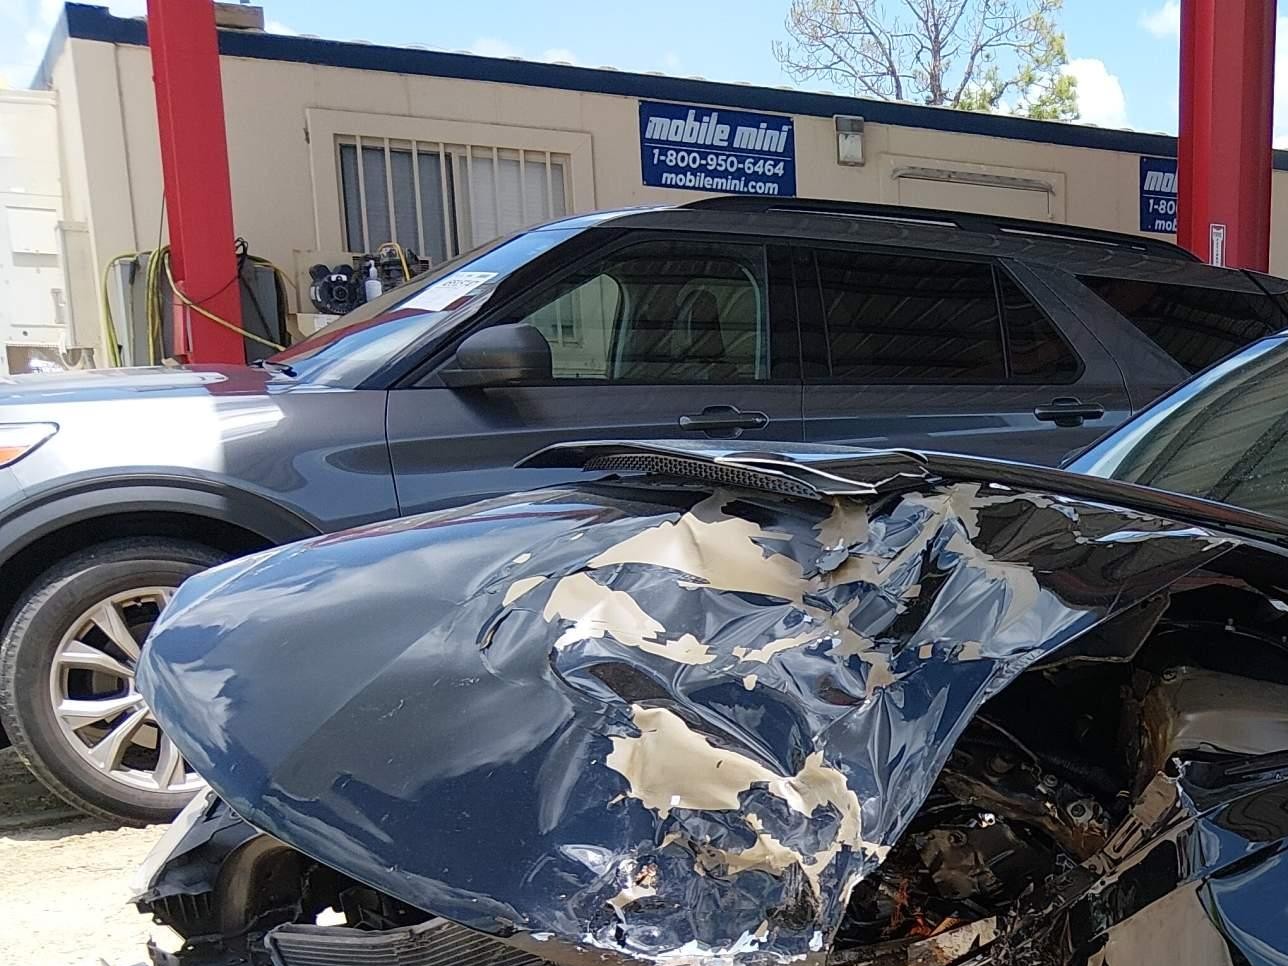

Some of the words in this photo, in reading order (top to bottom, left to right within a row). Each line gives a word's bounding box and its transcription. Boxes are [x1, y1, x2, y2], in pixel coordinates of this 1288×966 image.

[645, 109, 730, 147] mobile
[733, 122, 788, 152] mini
[652, 149, 785, 177] 1-800-950-6464
[661, 172, 779, 195] mobilemini.com
